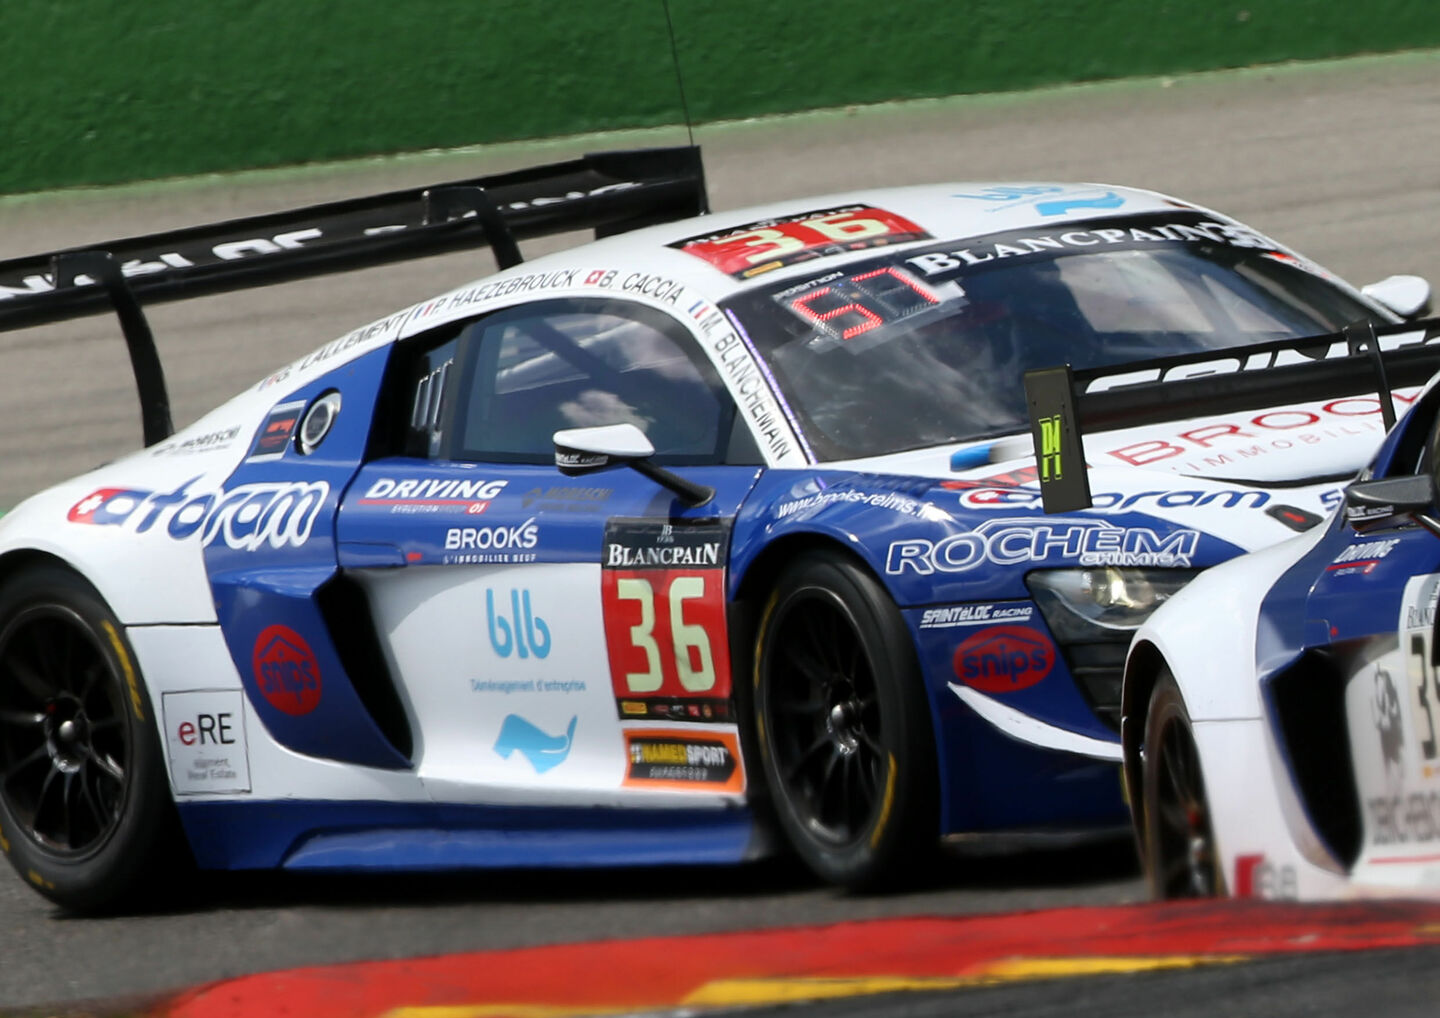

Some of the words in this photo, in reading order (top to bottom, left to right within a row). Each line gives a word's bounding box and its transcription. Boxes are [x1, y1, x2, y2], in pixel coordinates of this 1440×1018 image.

[713, 212, 891, 263] 36
[905, 221, 1227, 276] BLANCPAIN
[453, 269, 583, 308] HAEZEBROUCK
[622, 273, 685, 305] CACCIA
[772, 271, 845, 301] POSITION
[364, 478, 509, 499] DRIVING
[777, 489, 940, 522] www.brooks-reims.f
[445, 517, 539, 549] BROOKS
[885, 518, 1200, 575] ROCHEM
[607, 543, 720, 566] BLANCPAIN
[1080, 552, 1192, 567] CHIMICA
[486, 588, 551, 659] blb
[992, 607, 1033, 618] RACING
[618, 577, 716, 692] 36
[961, 644, 1048, 682] snips
[178, 713, 236, 746] eRE
